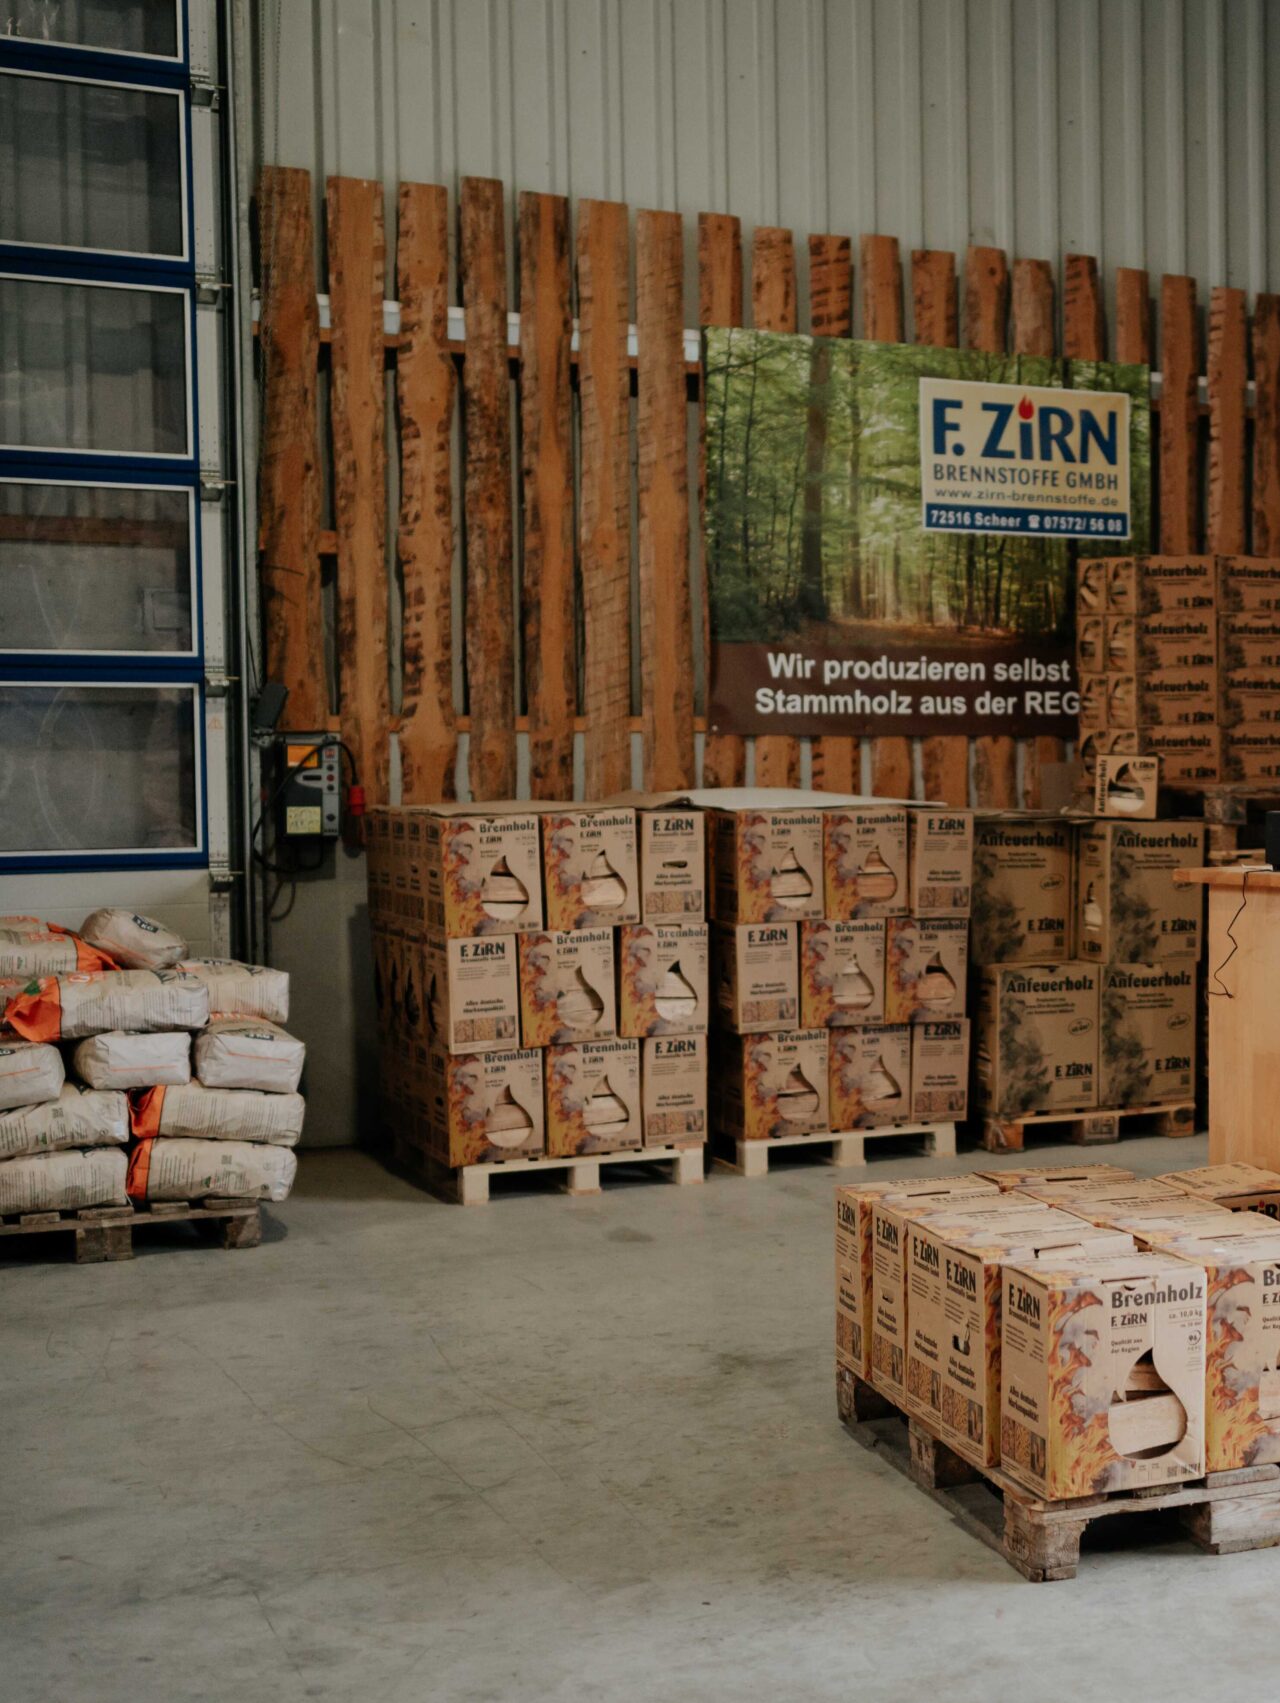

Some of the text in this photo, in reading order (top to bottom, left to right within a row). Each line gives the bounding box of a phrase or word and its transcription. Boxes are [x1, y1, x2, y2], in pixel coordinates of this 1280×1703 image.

[932, 395, 1117, 466] F. ZiRN
[933, 463, 1118, 491] BRENNSTOFFE GMBH
[935, 488, 1119, 507] www.zirn-brennstoffe.de
[930, 509, 1122, 532] 72516 Scheer 07572/ 56 08
[767, 652, 1070, 685] Wir produzieren selbst
[755, 688, 912, 715] Stammholz
[919, 695, 967, 715] aus
[974, 691, 1017, 715] der
[580, 815, 633, 828] Brennholz
[771, 815, 820, 826] Brennholz
[857, 814, 905, 825] Brennholz
[479, 821, 536, 833] Brennholz
[979, 832, 1065, 847] Anfeuerholz
[1117, 833, 1199, 848] Anfeuerholz
[835, 922, 883, 933] Brennholz
[920, 920, 967, 931] Brennholz
[557, 932, 611, 946] Brennholz
[657, 928, 708, 939] Brennholz
[1006, 975, 1094, 993] Anfeuerholz
[1108, 971, 1192, 989] Anfeuerholz
[778, 1030, 827, 1043] Brennholz
[582, 1041, 637, 1053] Brennholz
[484, 1050, 539, 1063] Brennholz
[1111, 1281, 1202, 1309] Brennholz
[1121, 1312, 1147, 1326] ZiRN
